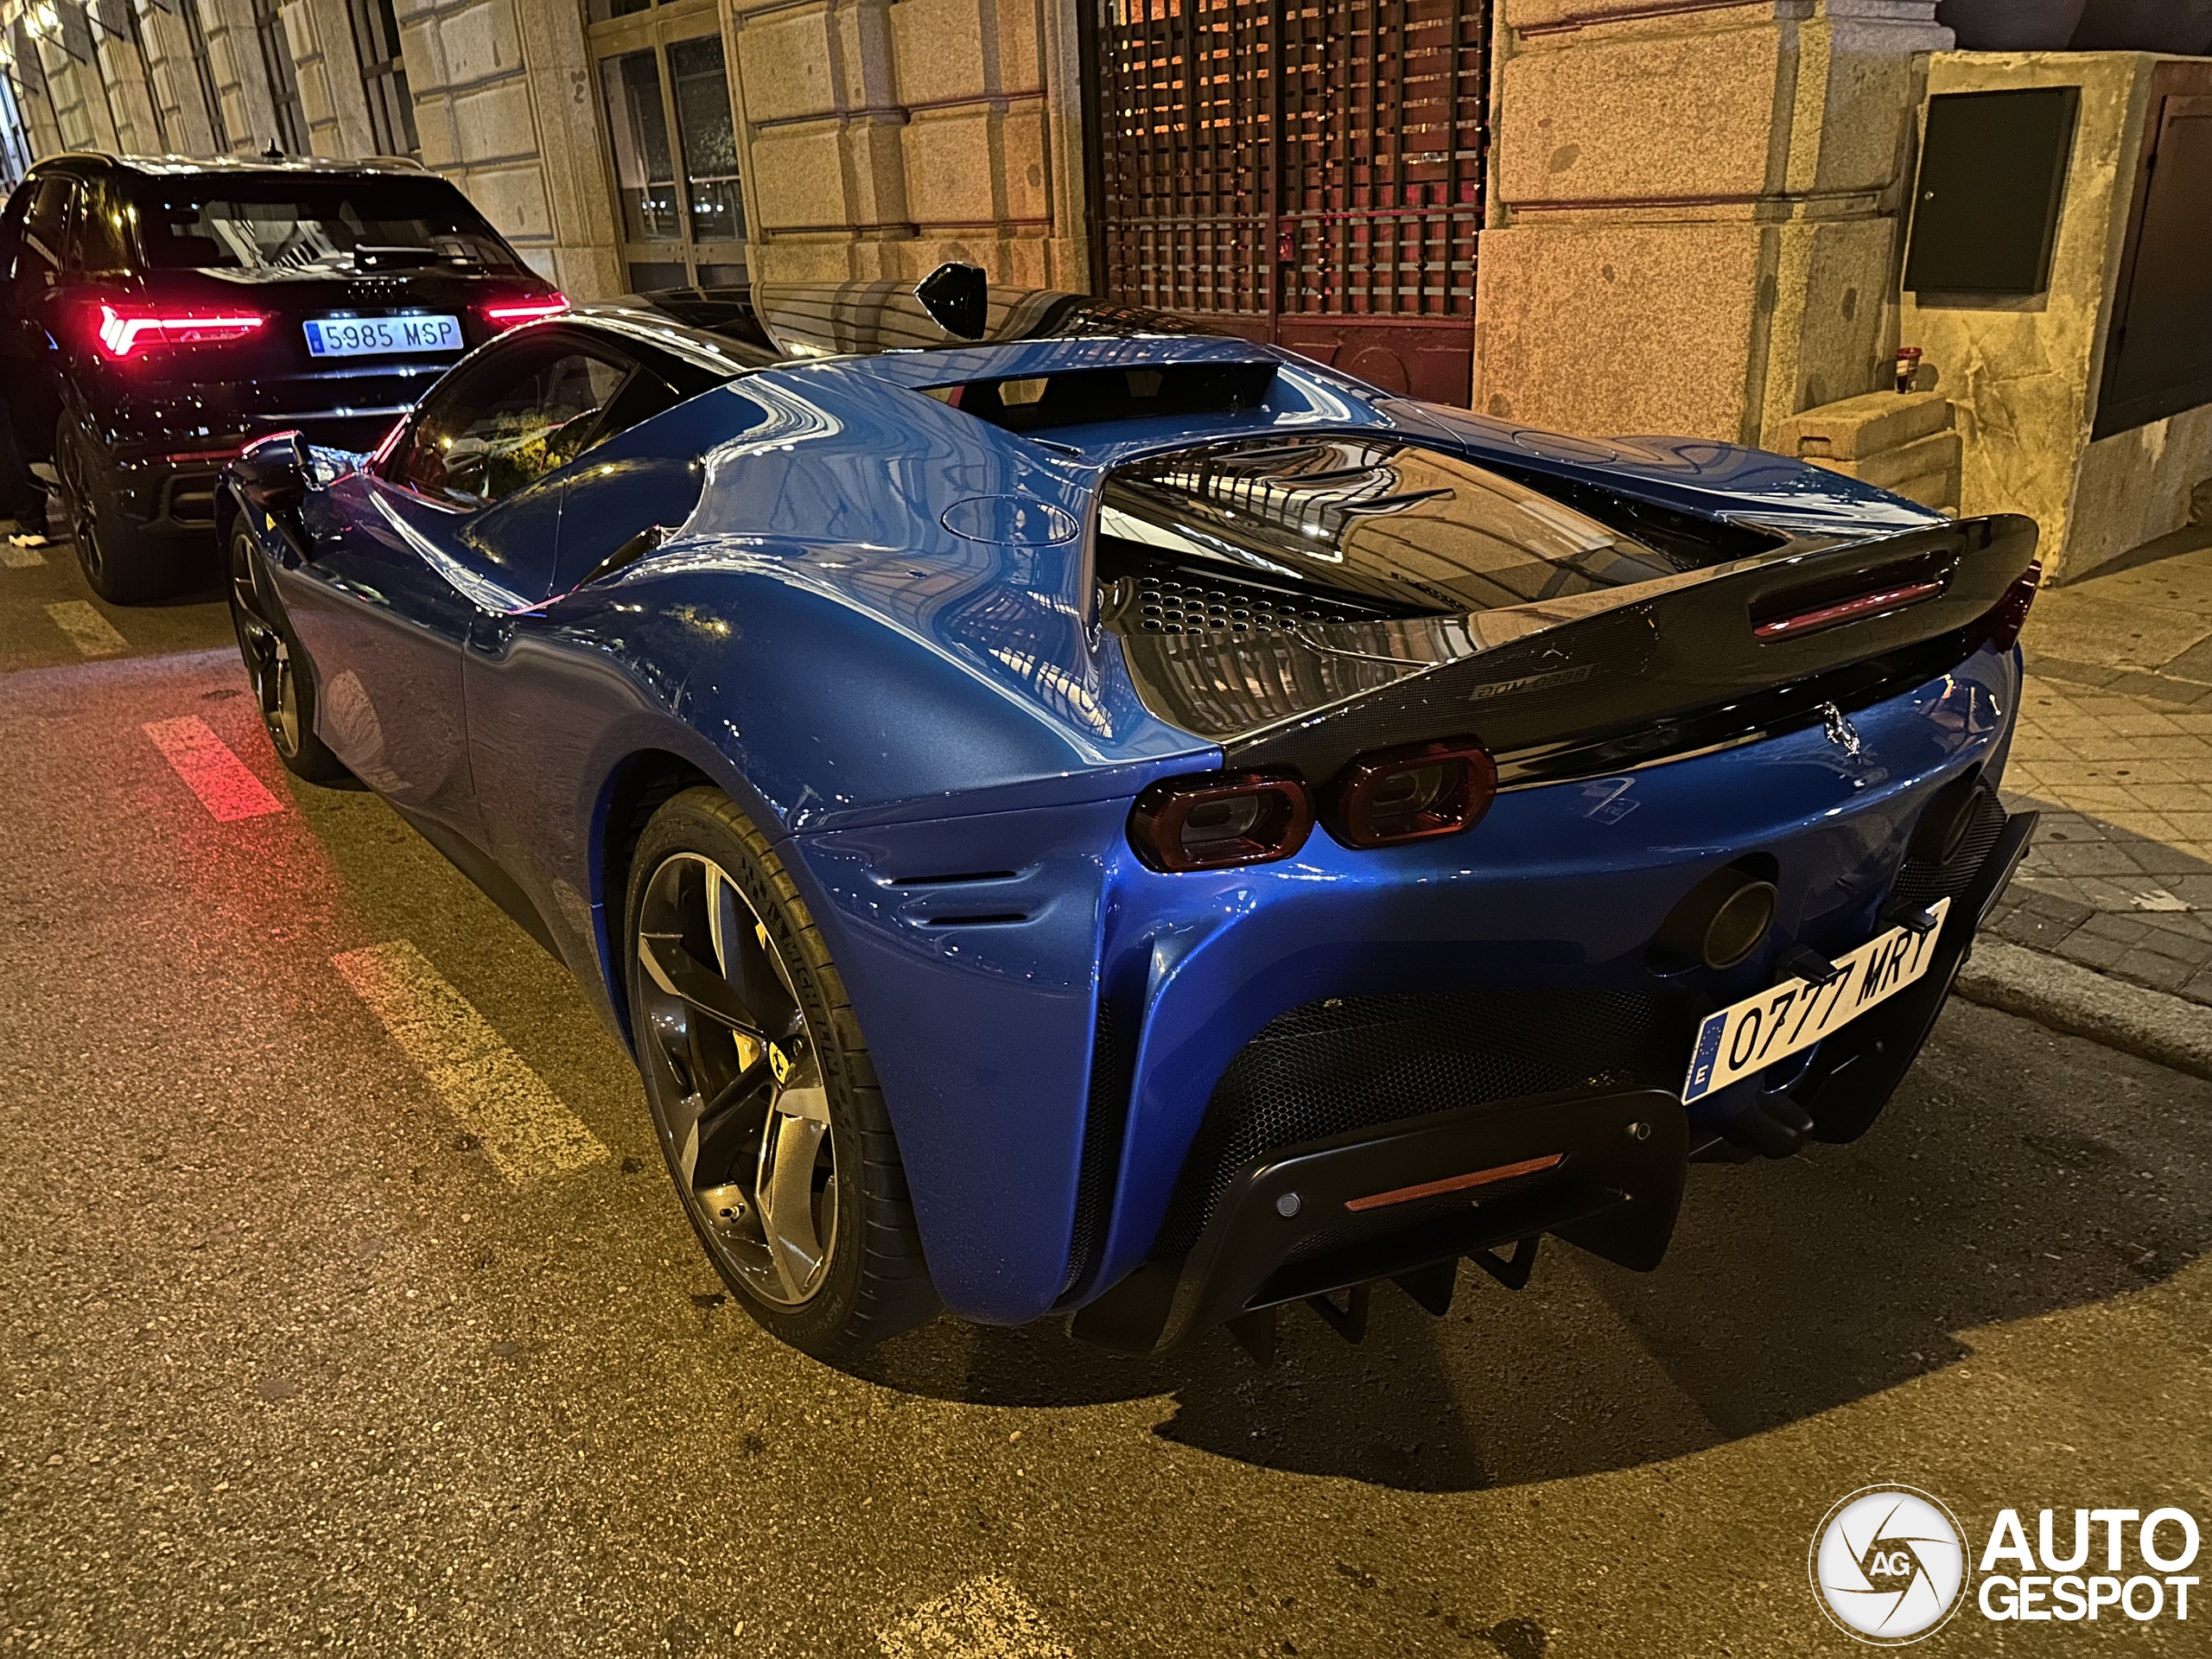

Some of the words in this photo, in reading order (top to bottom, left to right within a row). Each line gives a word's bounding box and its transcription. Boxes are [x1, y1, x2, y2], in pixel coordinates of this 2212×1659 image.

[326, 323, 393, 350] 5985
[403, 321, 452, 346] MSP
[781, 937, 841, 1077] MICHELIN
[1728, 960, 1857, 1071] 0777
[1855, 912, 1940, 1008] MRY
[1694, 1064, 1709, 1085] E
